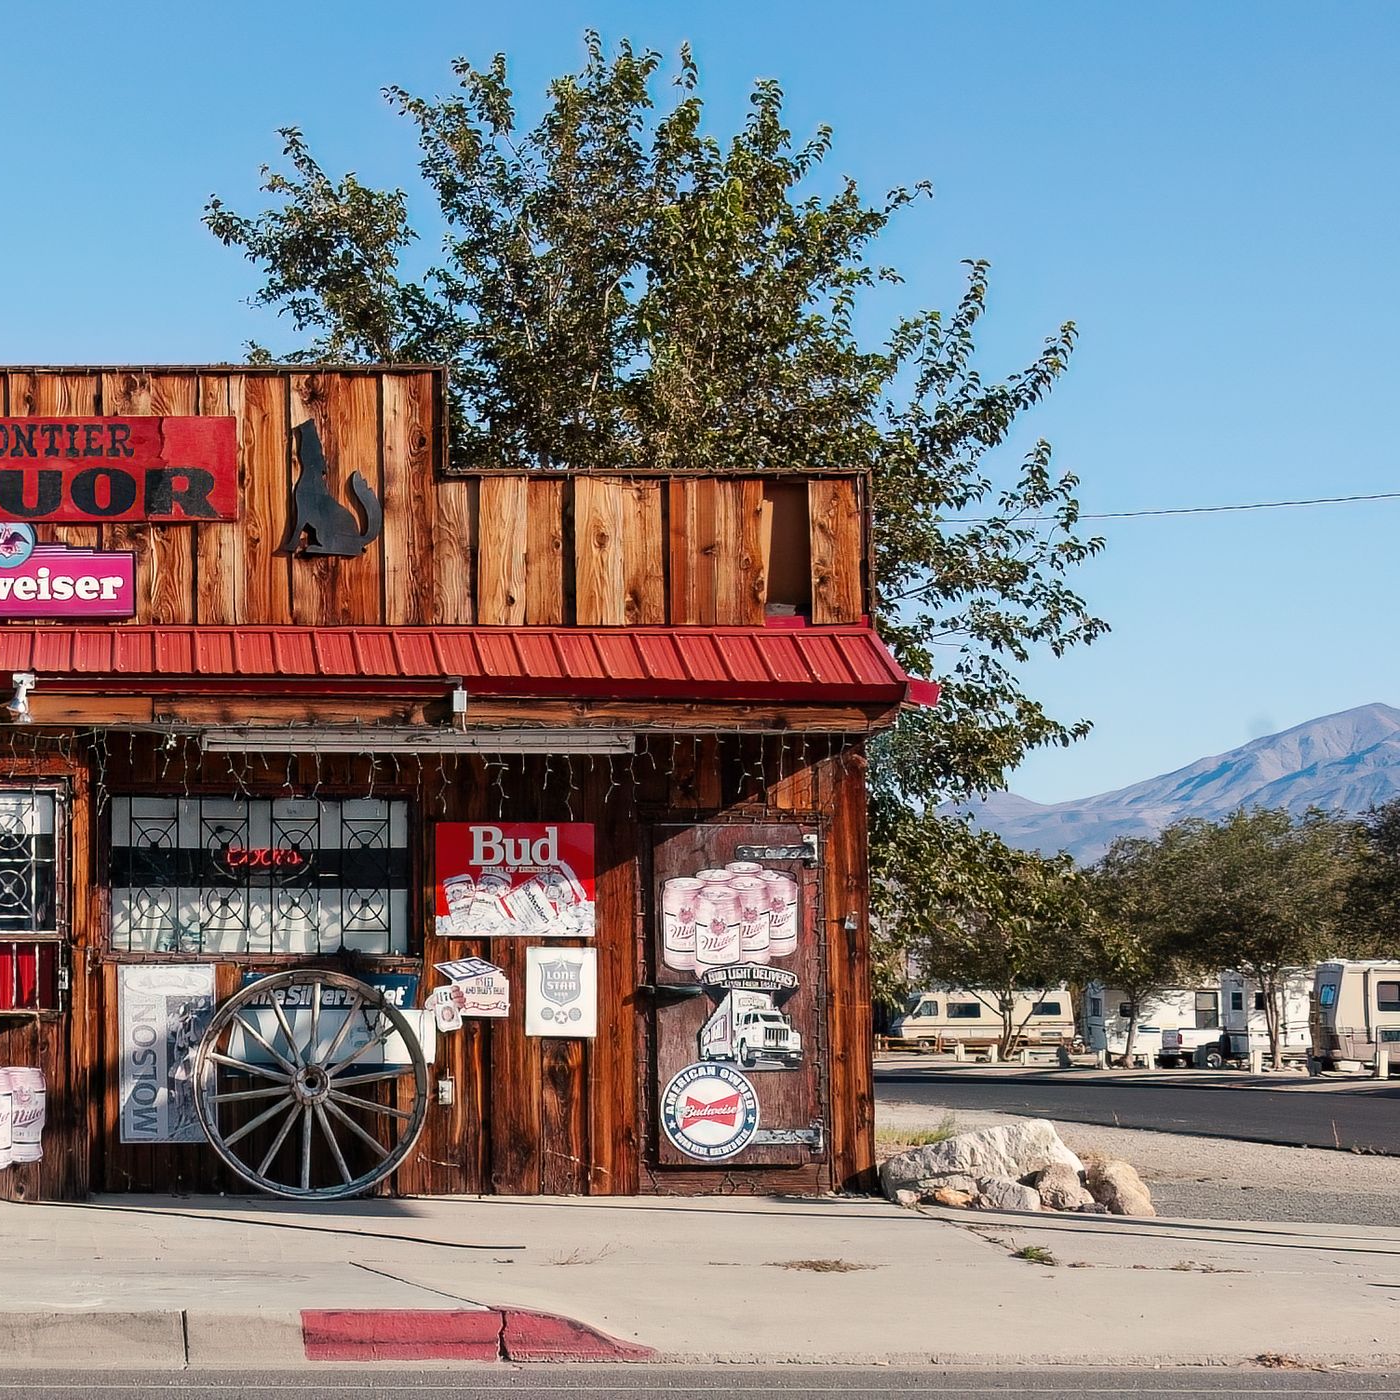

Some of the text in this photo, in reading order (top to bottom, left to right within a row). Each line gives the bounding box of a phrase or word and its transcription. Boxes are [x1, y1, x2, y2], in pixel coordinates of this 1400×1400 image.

[469, 826, 562, 866] Bud
[670, 924, 695, 938] Mill
[701, 933, 737, 951] Miller
[546, 970, 577, 981] LONE
[727, 967, 752, 981] LIGHT
[752, 967, 794, 987] DELIVERS
[347, 984, 406, 1006] Bet
[546, 981, 577, 991] STAR
[132, 1003, 158, 1135] MOLSON
[665, 1066, 755, 1115] AMERICAN OWNED
[680, 1103, 740, 1119] Budweise
